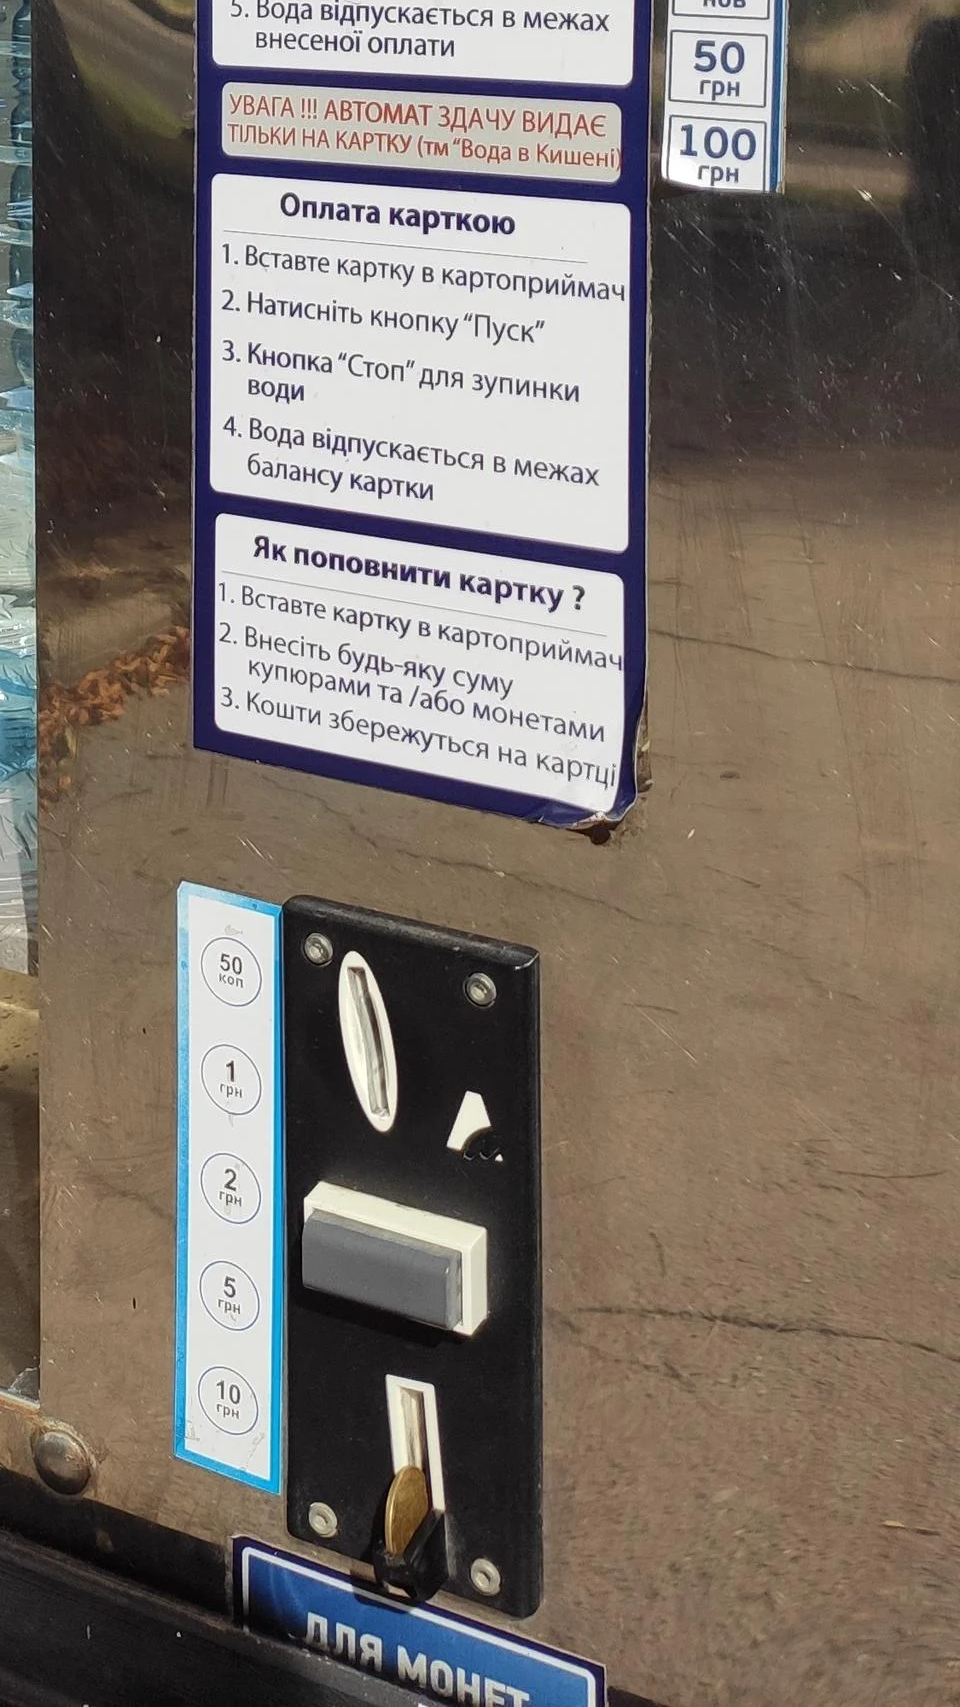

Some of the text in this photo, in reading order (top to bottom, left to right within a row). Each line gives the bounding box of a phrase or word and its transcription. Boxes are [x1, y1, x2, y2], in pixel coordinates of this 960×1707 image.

[523, 11, 610, 32] межах
[255, 29, 455, 57] внесеної оплати
[693, 39, 745, 75] 50
[699, 79, 740, 102] грн
[229, 93, 607, 140] УВАГА АВТОМАТ ЗДАЧУ ВИДАЄ
[227, 123, 296, 147] ТІЛЬКИ
[302, 128, 330, 149] НА
[336, 130, 413, 154] КАРТКУ
[679, 123, 757, 161] 100
[697, 164, 740, 187] грн
[280, 192, 516, 235] Оплата карткою
[245, 244, 625, 302] Вставте картку картоприймач
[247, 290, 363, 325] Натисніть
[370, 309, 459, 341] кнопку
[247, 341, 333, 374] Кнопка
[418, 367, 464, 391] для
[471, 373, 580, 403] зупинки
[247, 378, 305, 405] води
[249, 417, 600, 487] Вода відпускається межах
[247, 452, 434, 501] балансу картки
[253, 535, 565, 614] Як поповнити картку
[241, 585, 623, 671] Вставте картку картоприймач
[245, 625, 514, 701] Внесіть будь-яку суму
[248, 660, 371, 698] купюрами
[376, 684, 403, 704] та
[472, 702, 605, 743] монетами
[247, 690, 617, 791] Кошти збережуться на картці
[219, 953, 243, 976] 50
[218, 973, 244, 989] коп
[225, 1060, 235, 1083] 1
[219, 1083, 243, 1099] грн
[223, 1168, 237, 1192] 2
[219, 1190, 242, 1207] грн
[223, 1275, 236, 1299] 5
[217, 1298, 241, 1315] грн
[216, 1380, 241, 1405] 10
[216, 1403, 240, 1420] грн
